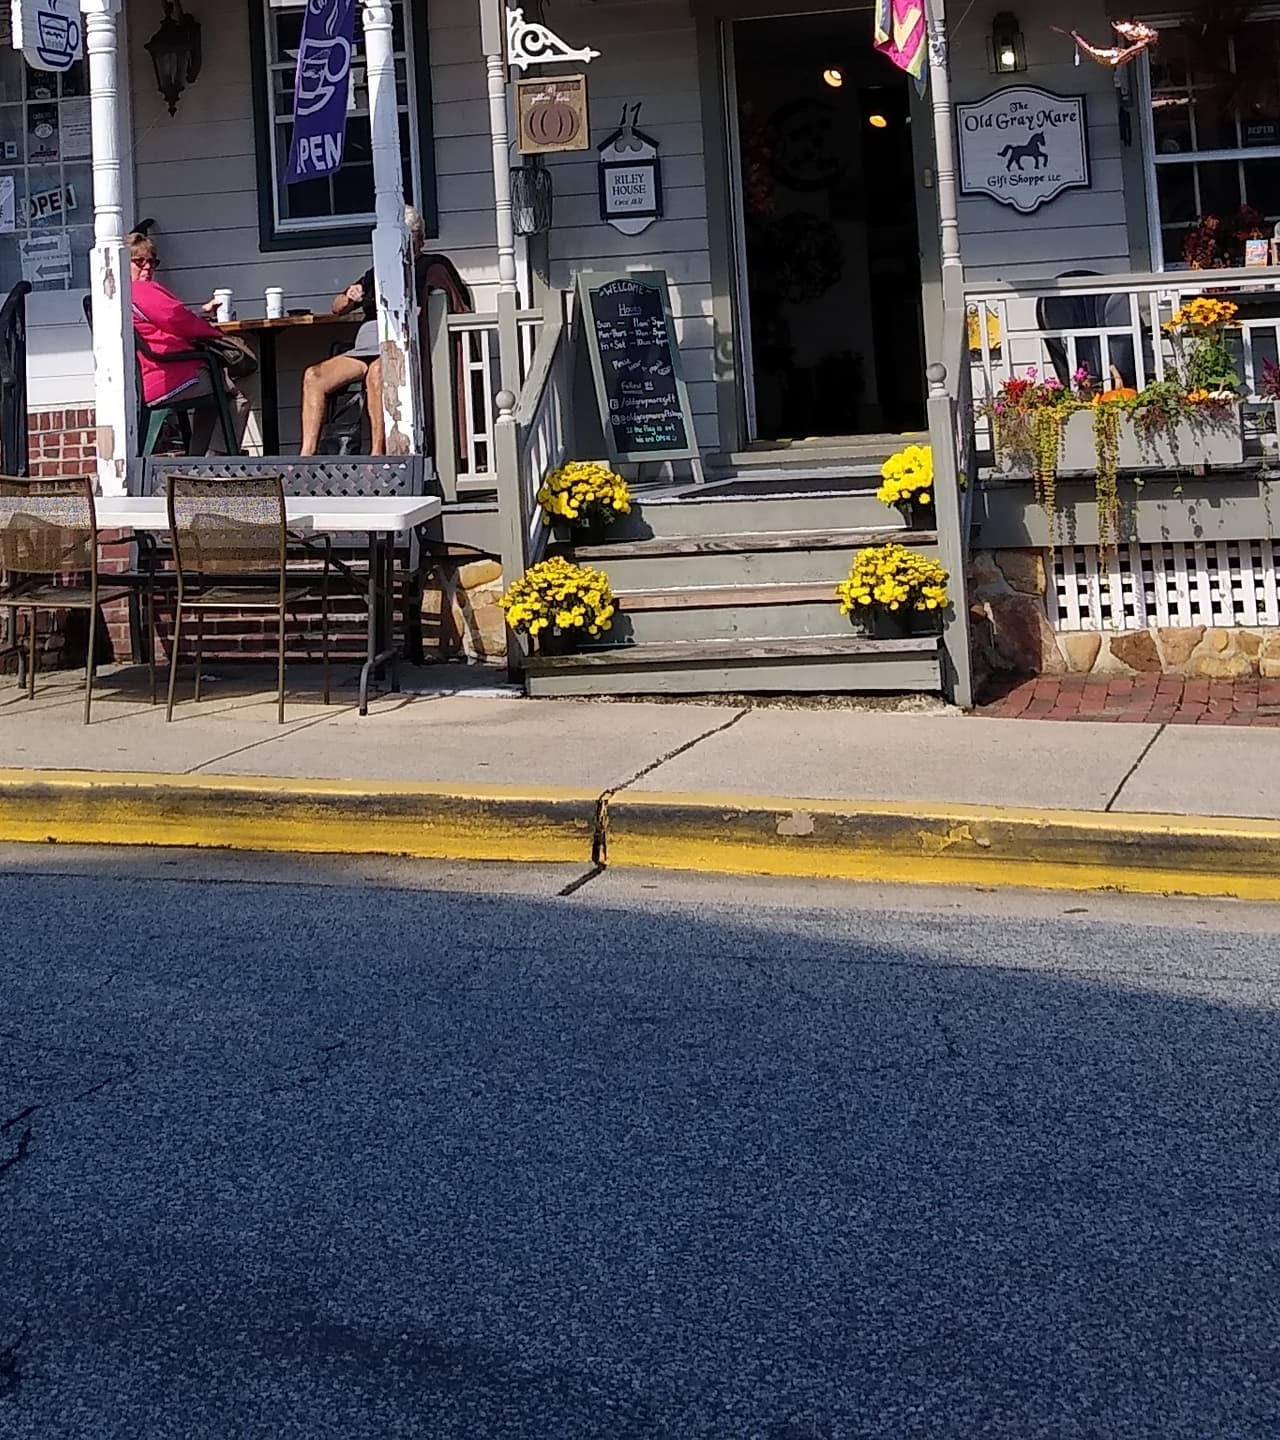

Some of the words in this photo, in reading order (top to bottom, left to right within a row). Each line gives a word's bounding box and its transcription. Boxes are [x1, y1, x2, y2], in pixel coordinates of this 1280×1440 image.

[620, 101, 642, 127] 17
[1009, 102, 1029, 113] The
[965, 114, 993, 132] Old
[996, 112, 1034, 131] Gray
[1036, 109, 1078, 129] Mare
[296, 132, 342, 174] PEN
[614, 173, 645, 185] RILEY
[987, 174, 1008, 188] Gift
[1009, 174, 1045, 186] Shoppe
[612, 184, 647, 196] HOUSE
[24, 188, 75, 219] OPEN
[603, 281, 644, 296] WELCOME
